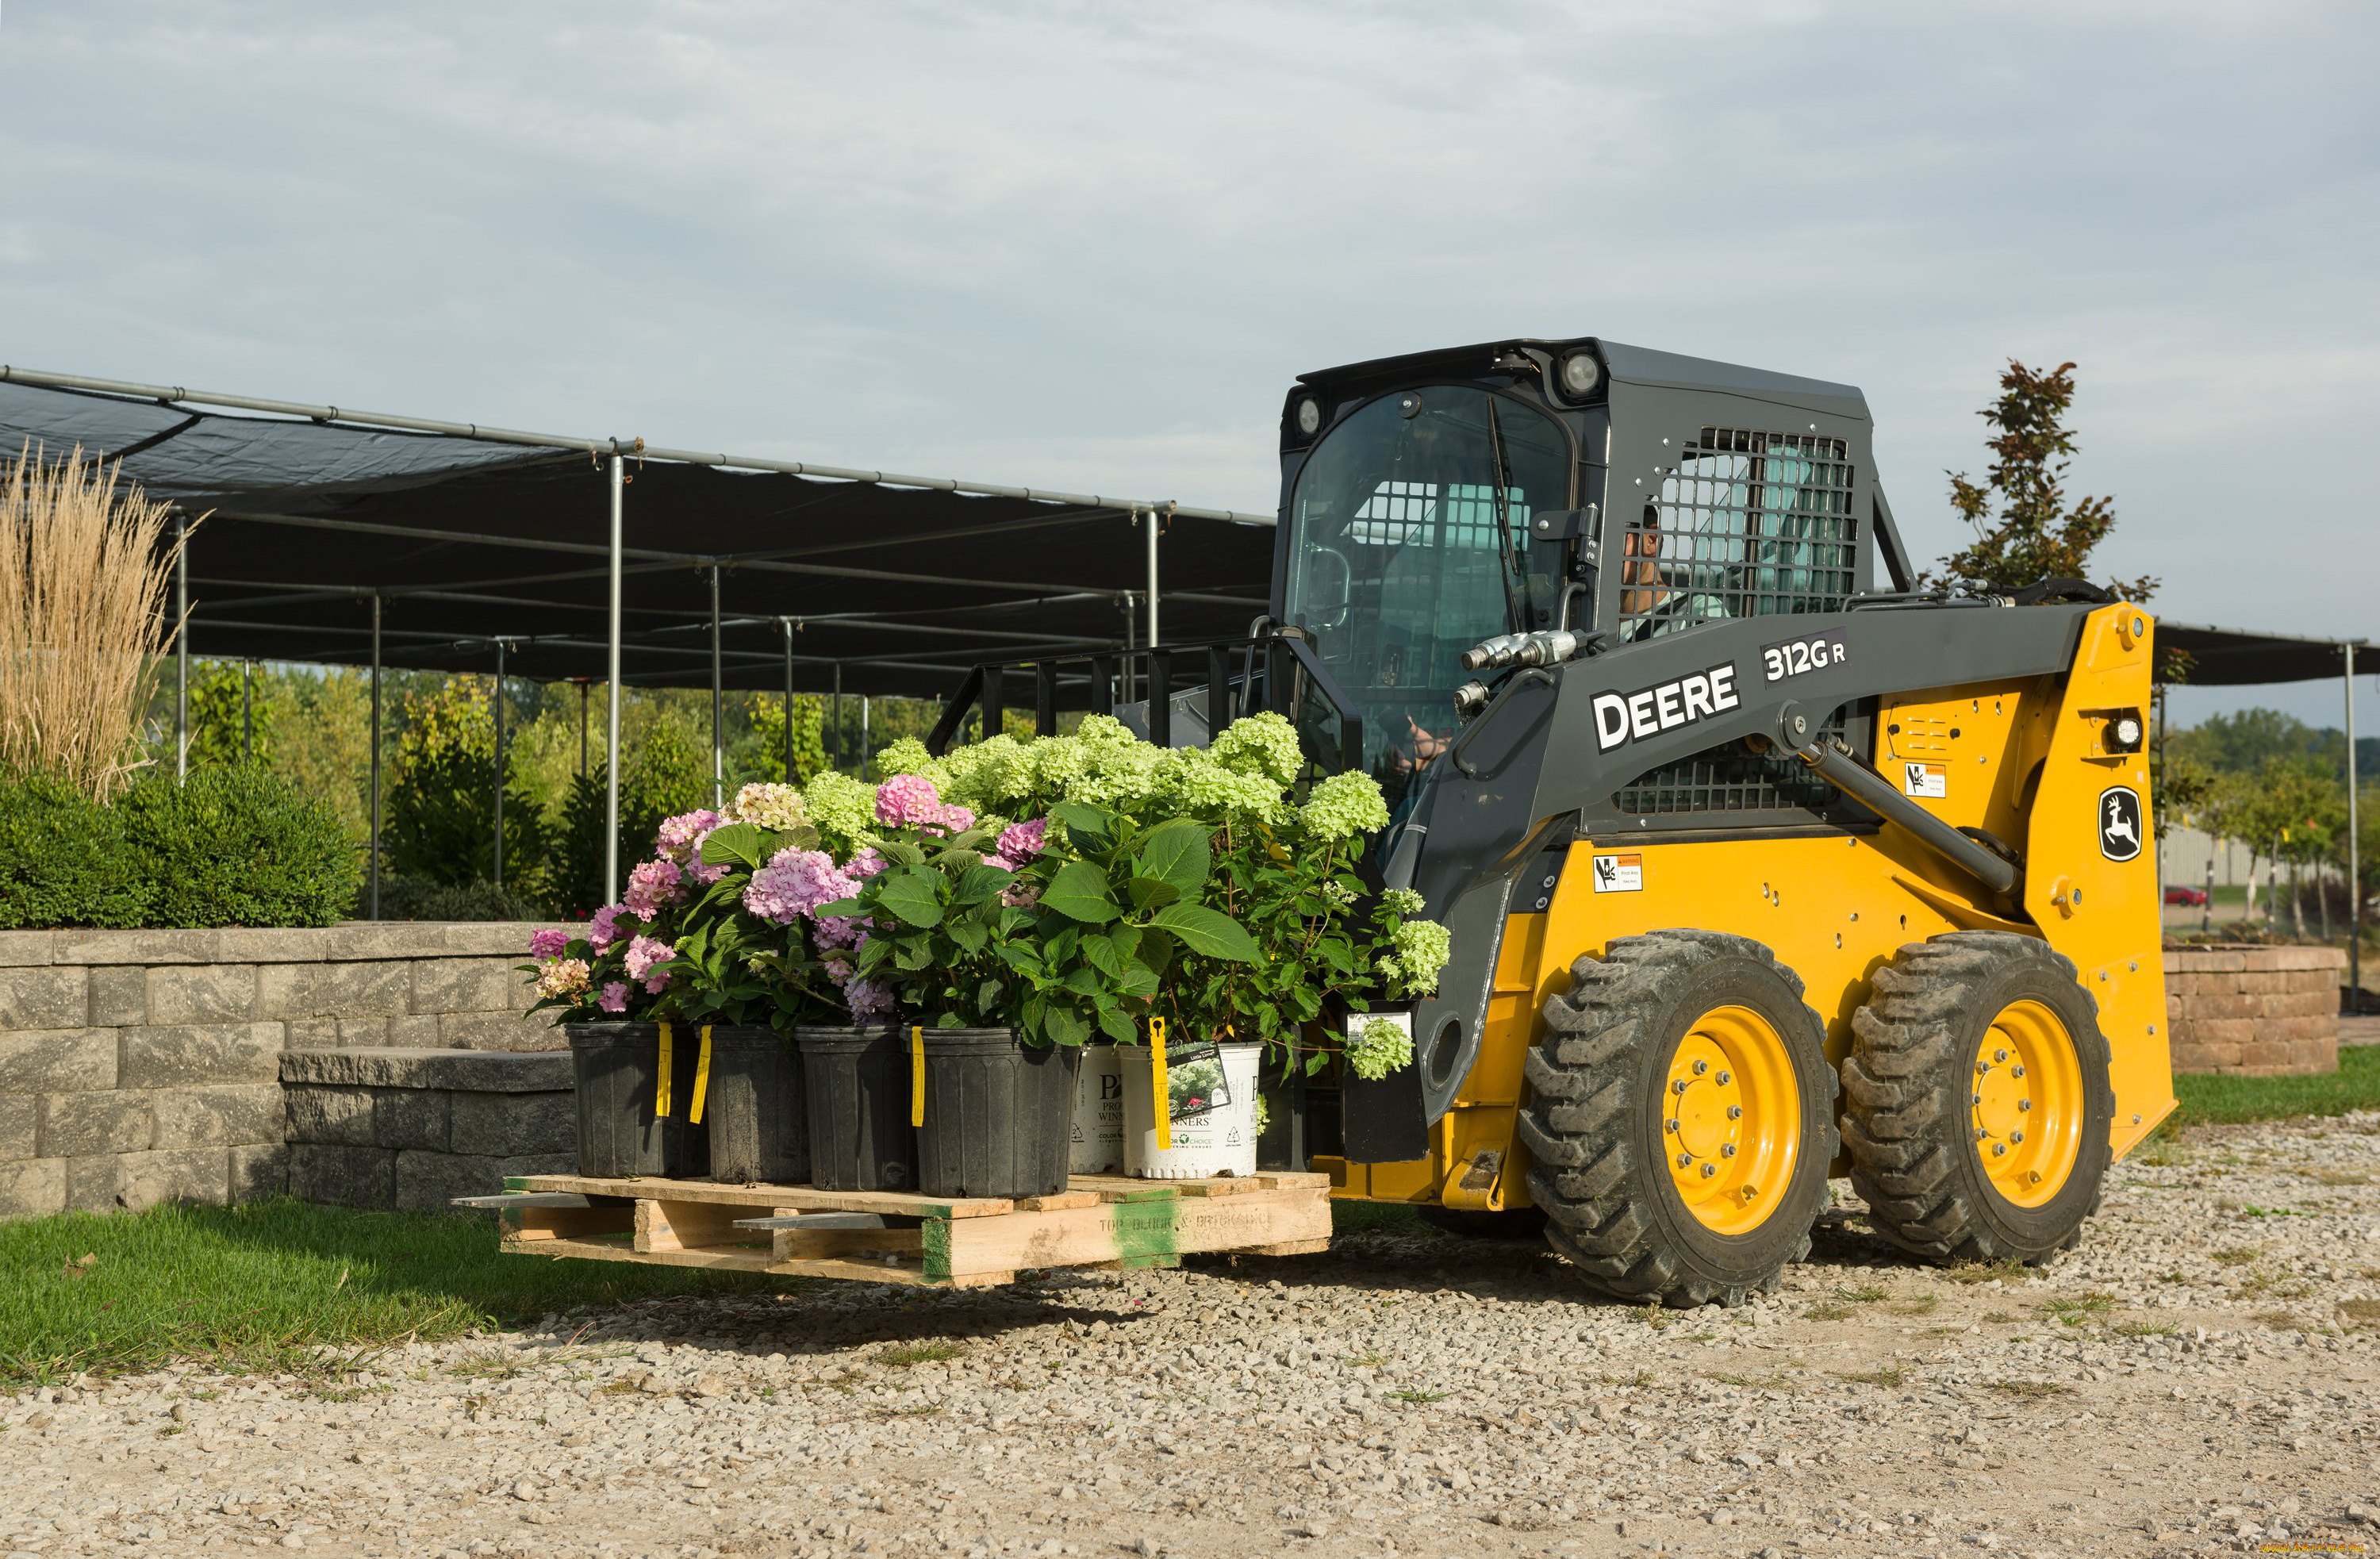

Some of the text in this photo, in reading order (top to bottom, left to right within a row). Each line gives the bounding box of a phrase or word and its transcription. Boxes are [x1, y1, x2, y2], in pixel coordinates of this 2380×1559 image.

[1764, 640, 1845, 682] 312G R
[1593, 664, 1739, 750] DEERE
[1098, 1074, 1123, 1100] P
[1103, 1102, 1123, 1111] PRO
[1098, 1112, 1123, 1121] WINN
[1171, 1117, 1209, 1127] NNERS
[1100, 1219, 1123, 1231] TOP
